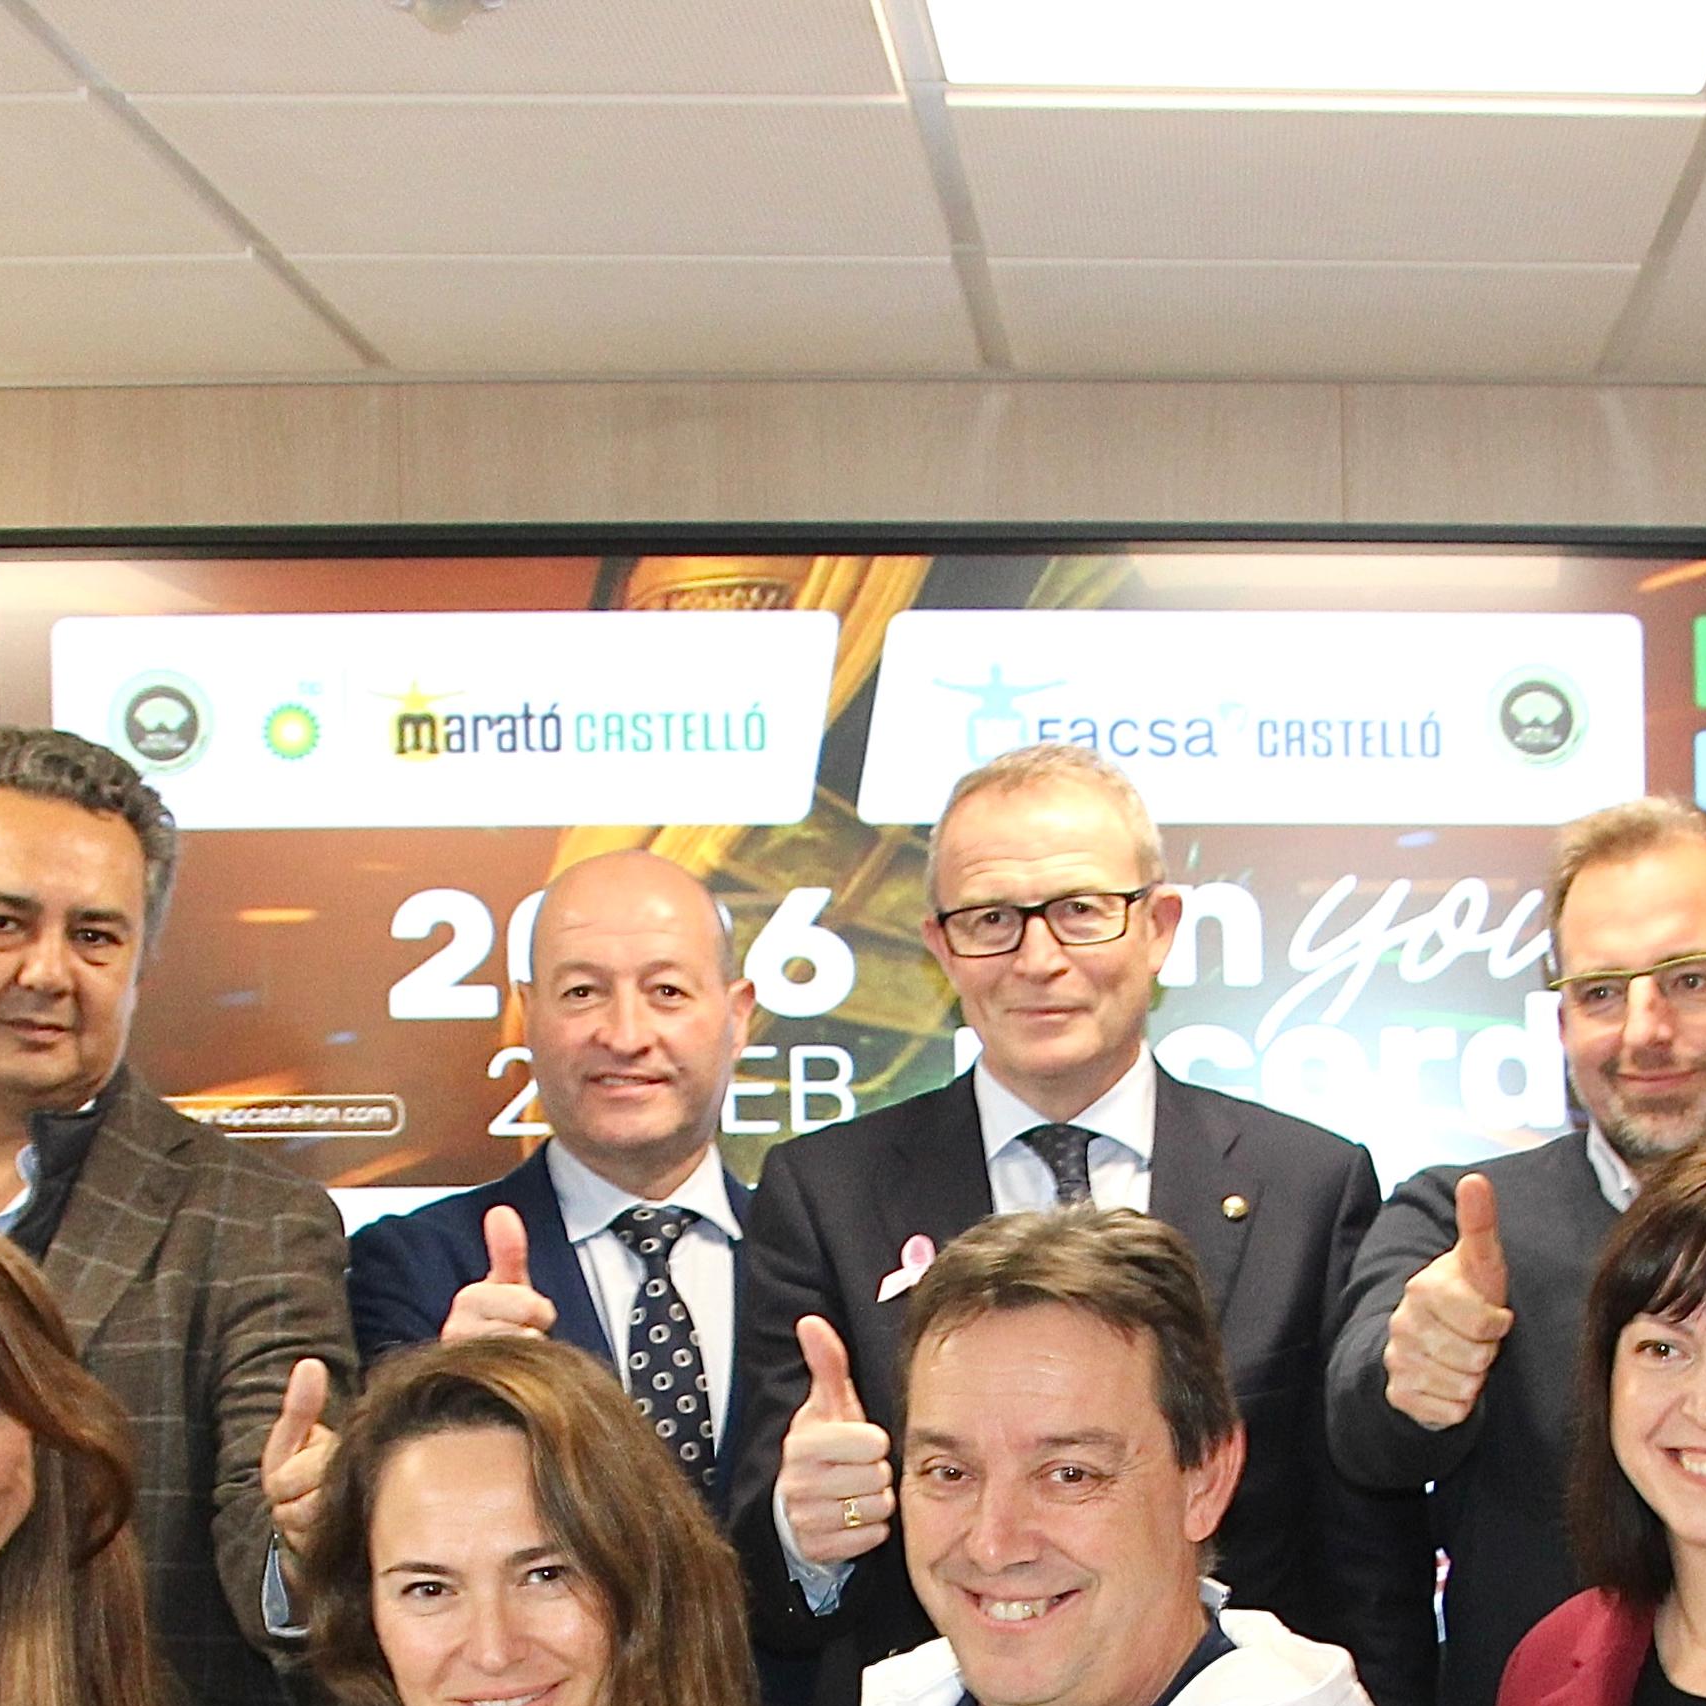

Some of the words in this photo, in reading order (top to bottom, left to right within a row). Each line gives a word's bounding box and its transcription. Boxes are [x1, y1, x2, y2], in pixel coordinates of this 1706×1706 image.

[394, 701, 563, 754] marató
[574, 701, 767, 753] CASTELLÓ
[1257, 710, 1442, 758] CASTELLÓ
[388, 886, 857, 1020] 26
[720, 1044, 857, 1136] EB
